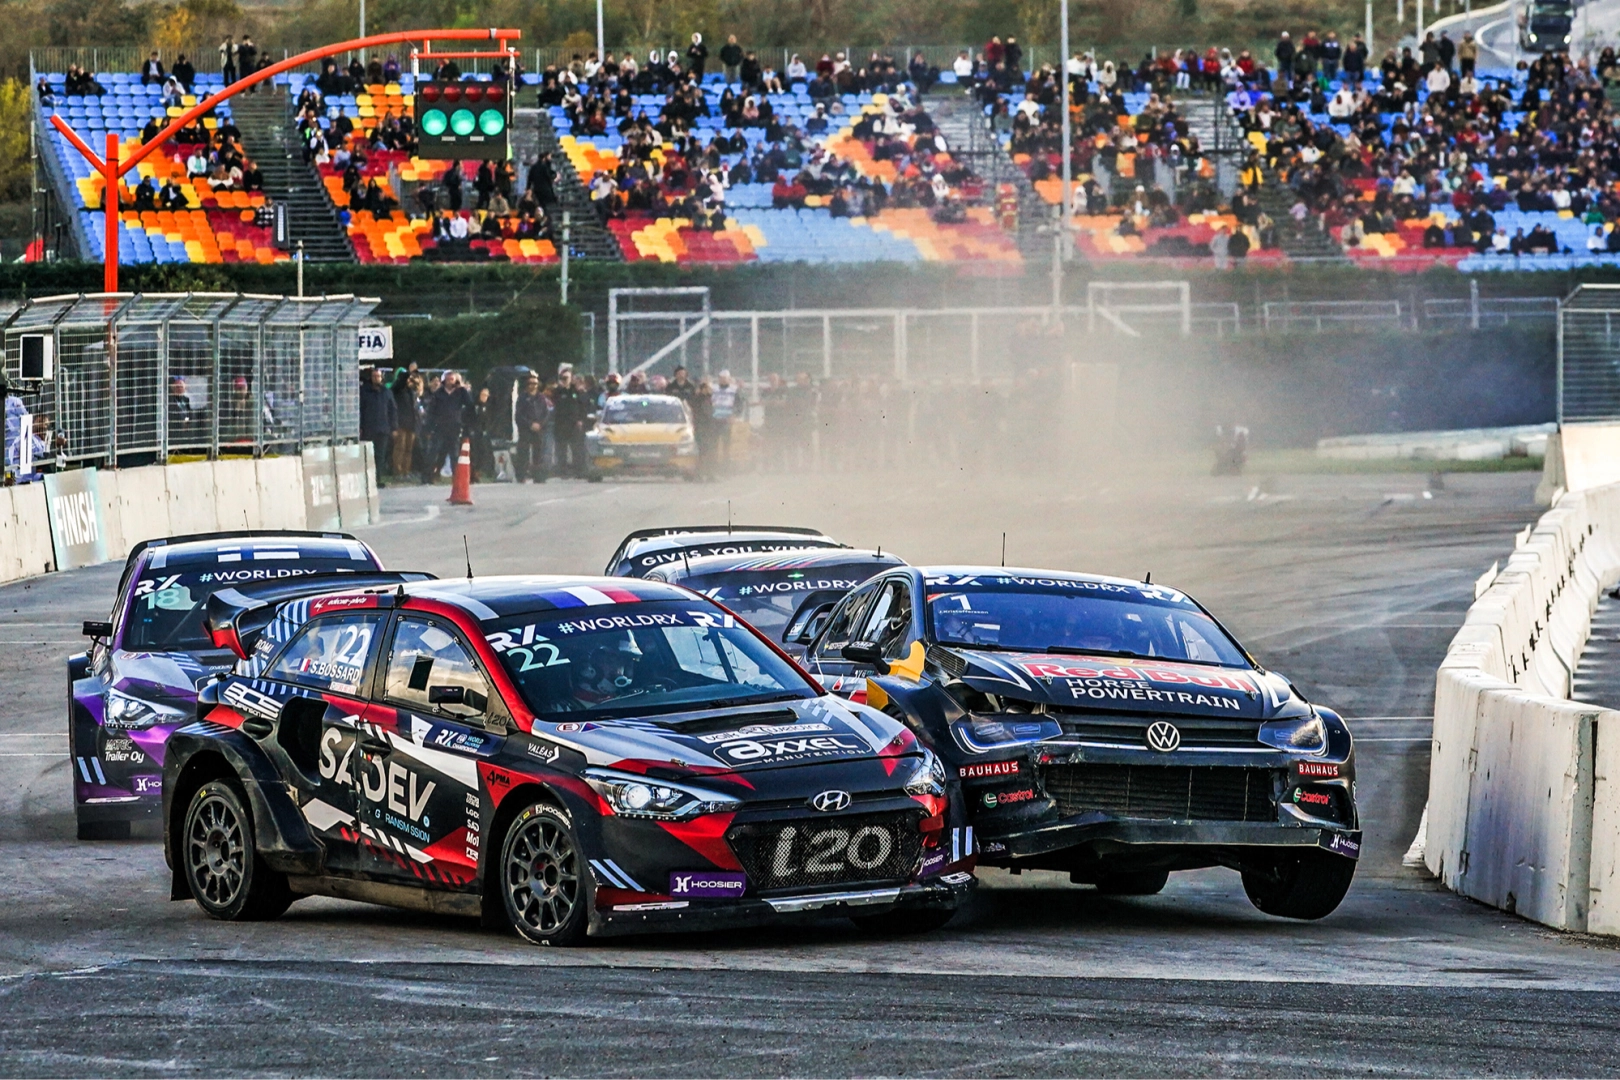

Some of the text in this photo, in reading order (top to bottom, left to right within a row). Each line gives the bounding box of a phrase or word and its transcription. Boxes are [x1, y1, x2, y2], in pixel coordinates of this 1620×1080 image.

[52, 491, 99, 548] FINISH
[641, 549, 702, 567] GIVES
[739, 579, 858, 596] #WORLDRX
[997, 576, 1130, 593] #WORLDRX
[141, 588, 180, 610] 18
[950, 594, 971, 610] 1
[558, 613, 683, 634] #WORLDRX
[337, 625, 371, 667] 22
[484, 624, 550, 652] RX
[507, 643, 570, 672] 22
[310, 661, 361, 681] S.BOSSARD
[1020, 662, 1258, 692] Red Bull
[1066, 678, 1153, 690] HORSE
[1070, 687, 1241, 711] POWERTRAIN
[435, 729, 459, 747] RX
[106, 751, 144, 763] Trailer Oy
[763, 749, 867, 764] MANUTENTION
[960, 761, 1019, 778] BAUHAUS
[1299, 764, 1339, 776] BAUHAUS
[998, 789, 1034, 804] Castrol
[1301, 791, 1329, 805] Castrol
[691, 880, 743, 890] HOOSIER
